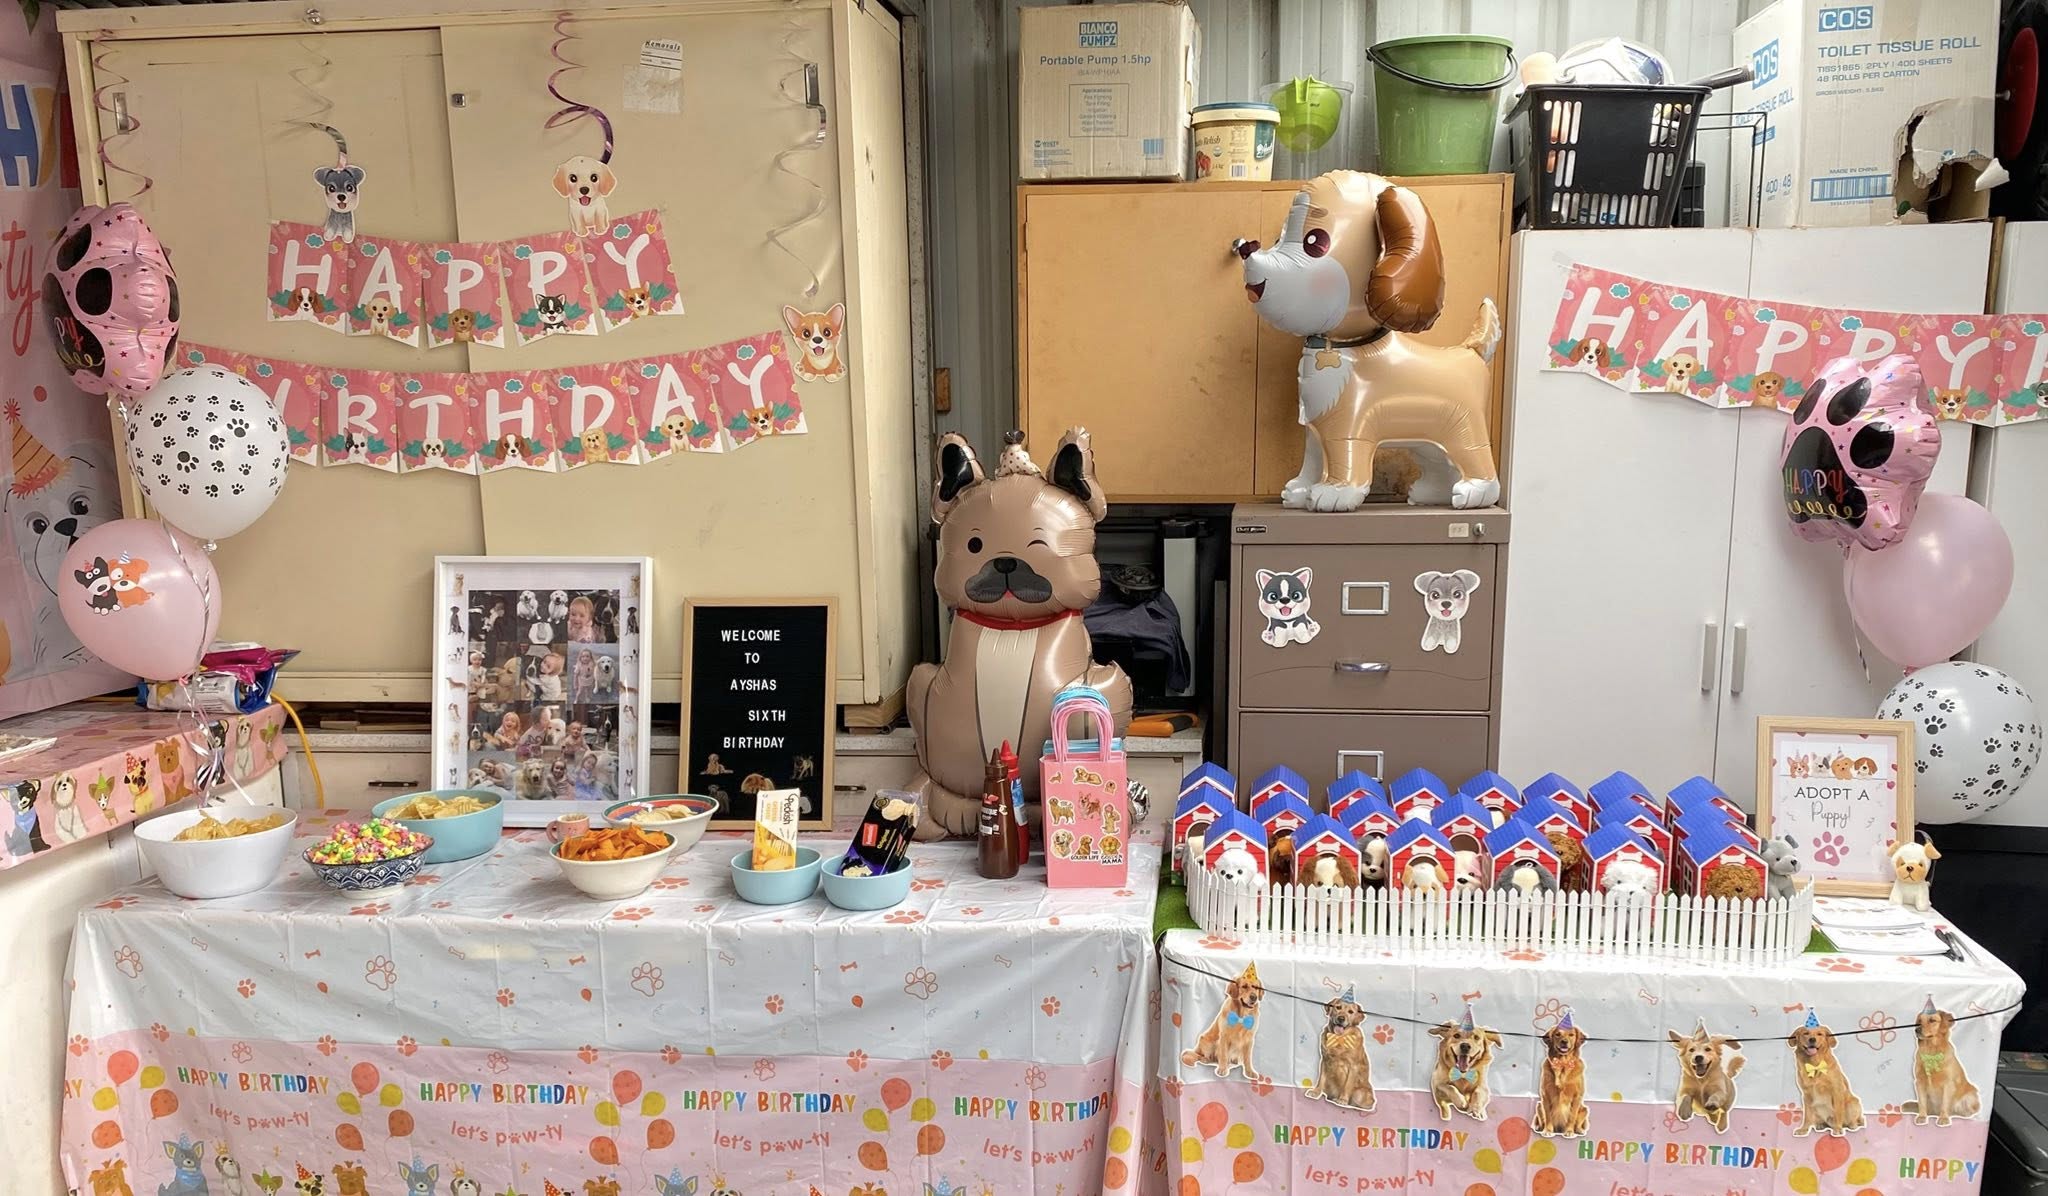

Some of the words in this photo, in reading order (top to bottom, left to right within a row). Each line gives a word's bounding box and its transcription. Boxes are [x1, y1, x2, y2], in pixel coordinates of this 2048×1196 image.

[1080, 23, 1117, 34] BIANCO
[1821, 8, 1872, 30] COS
[1080, 35, 1116, 46] PUMPZ
[1818, 44, 1872, 58] TOILET
[1877, 39, 1934, 53] TISSUE
[1940, 37, 1981, 49] ROLL
[1040, 56, 1083, 65] Portable
[1087, 55, 1118, 66] Pump
[1121, 54, 1152, 65] 1.5hp
[1754, 44, 1778, 85] COS
[1866, 61, 1889, 70] 2PLY
[1898, 60, 1916, 68] 400
[1919, 57, 1953, 66] SHEETS
[1817, 74, 1829, 82] 48
[1832, 73, 1860, 82] ROLLS
[1883, 70, 1920, 78] CARTON
[282, 233, 651, 310] HAPPY
[1567, 286, 1991, 391] HAPPY
[273, 355, 775, 444] IRTHDAY
[1784, 468, 1849, 502] HAPPY
[721, 629, 781, 642] WELCOME
[744, 652, 760, 664] TO
[730, 679, 777, 691] AYSHAS
[748, 710, 786, 721] SIXTH
[723, 737, 785, 749] BIRTHDAY
[1793, 786, 1853, 800] ADOPT
[1857, 789, 1870, 801] A
[1811, 801, 1851, 829] Puppy!
[177, 1066, 229, 1090] HAPPY
[238, 1072, 330, 1095] BIRTHDAY
[420, 1082, 482, 1103] HAPPY
[492, 1083, 589, 1105] BIRTHDAY
[683, 1090, 747, 1112] HAPPY
[757, 1091, 857, 1113] BIRTHDAY
[209, 1103, 241, 1127] let's
[954, 1096, 1018, 1120] HAPPY
[1028, 1091, 1109, 1122] BIRTHDA
[451, 1120, 489, 1143] let's
[713, 1129, 752, 1152] let's
[1274, 1124, 1346, 1147] HAPPY
[1357, 1127, 1470, 1151] BIRTHDAY
[983, 1137, 1023, 1163] let's
[1578, 1139, 1654, 1163] HAPPY
[1665, 1142, 1784, 1170] BIRTHDAY
[1304, 1164, 1349, 1189] let's
[1900, 1157, 1980, 1183] HAPPY
